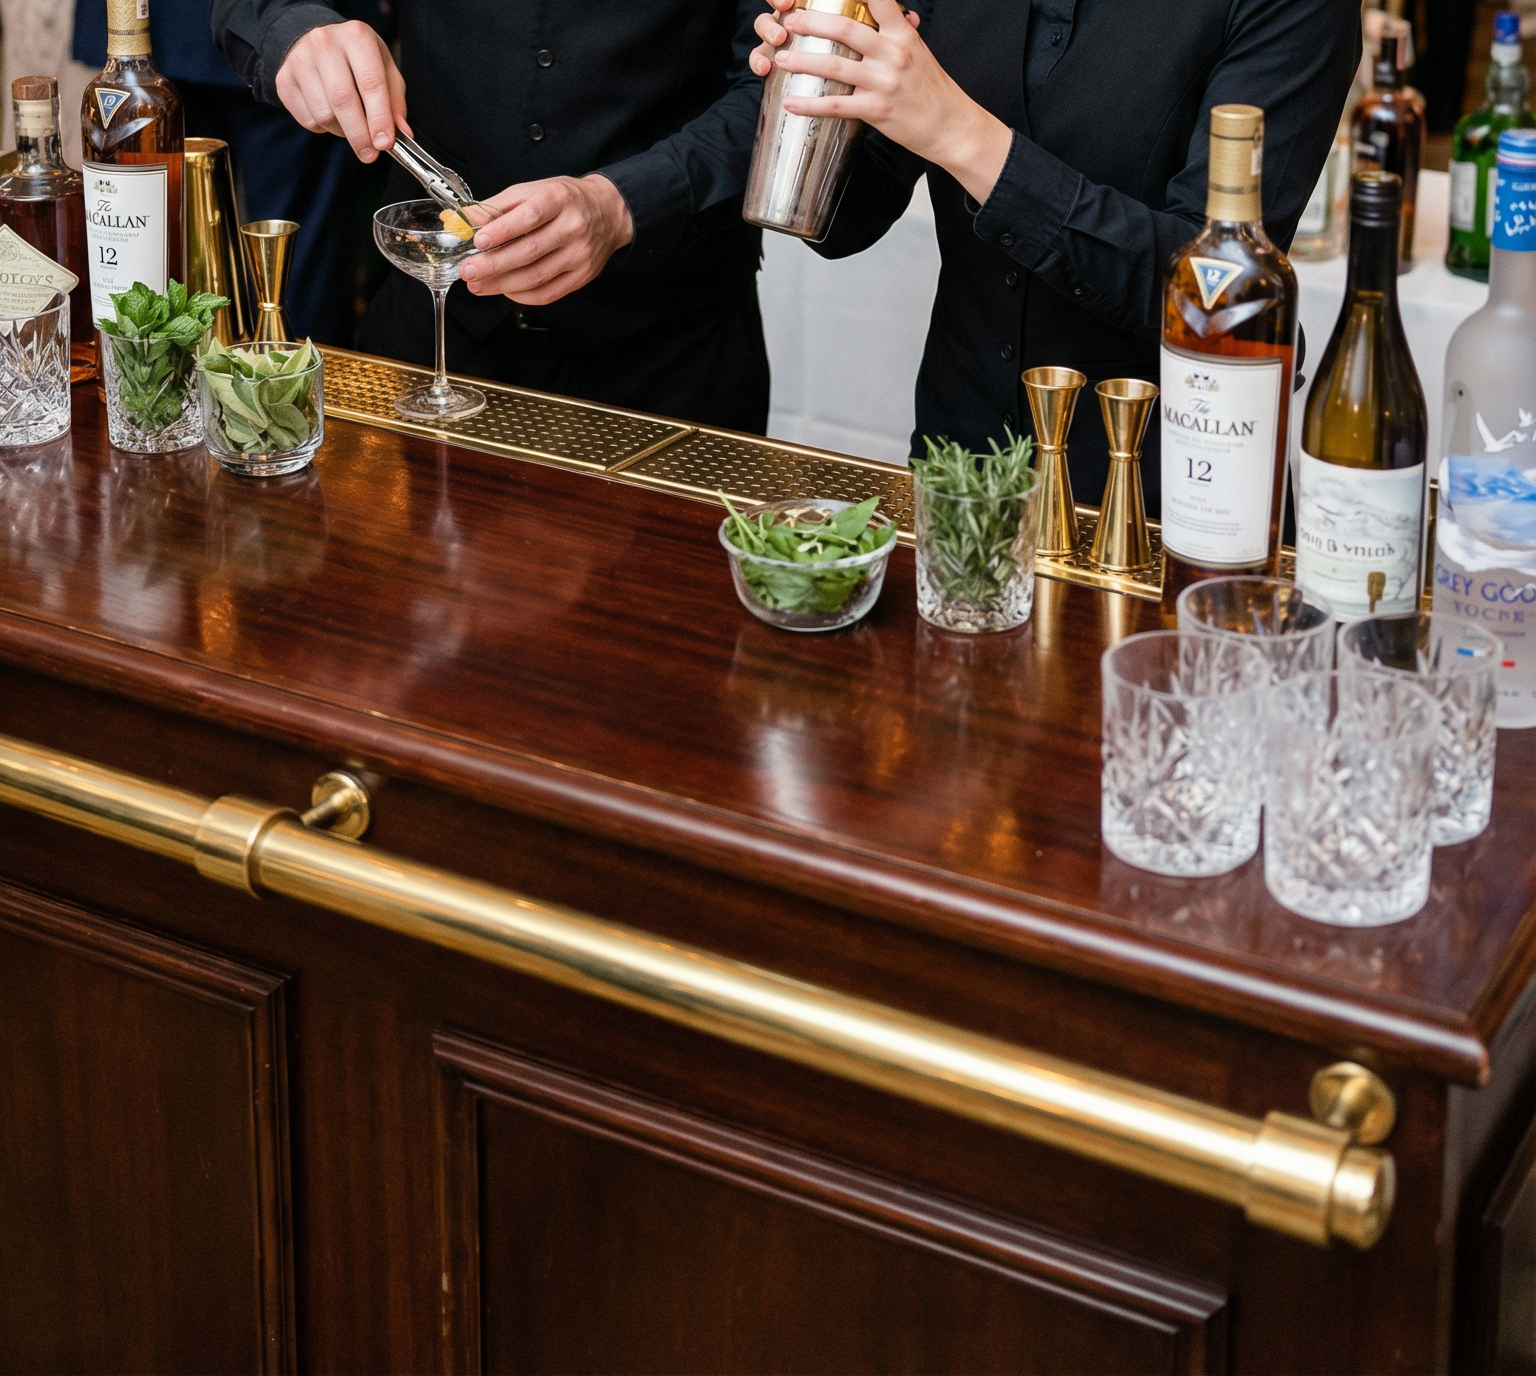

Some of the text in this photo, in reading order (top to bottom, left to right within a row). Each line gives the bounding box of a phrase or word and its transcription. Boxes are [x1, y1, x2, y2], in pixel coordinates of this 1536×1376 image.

[98, 245, 118, 266] 12
[1163, 404, 1256, 437] MACALLAN
[1186, 457, 1212, 483] 12
